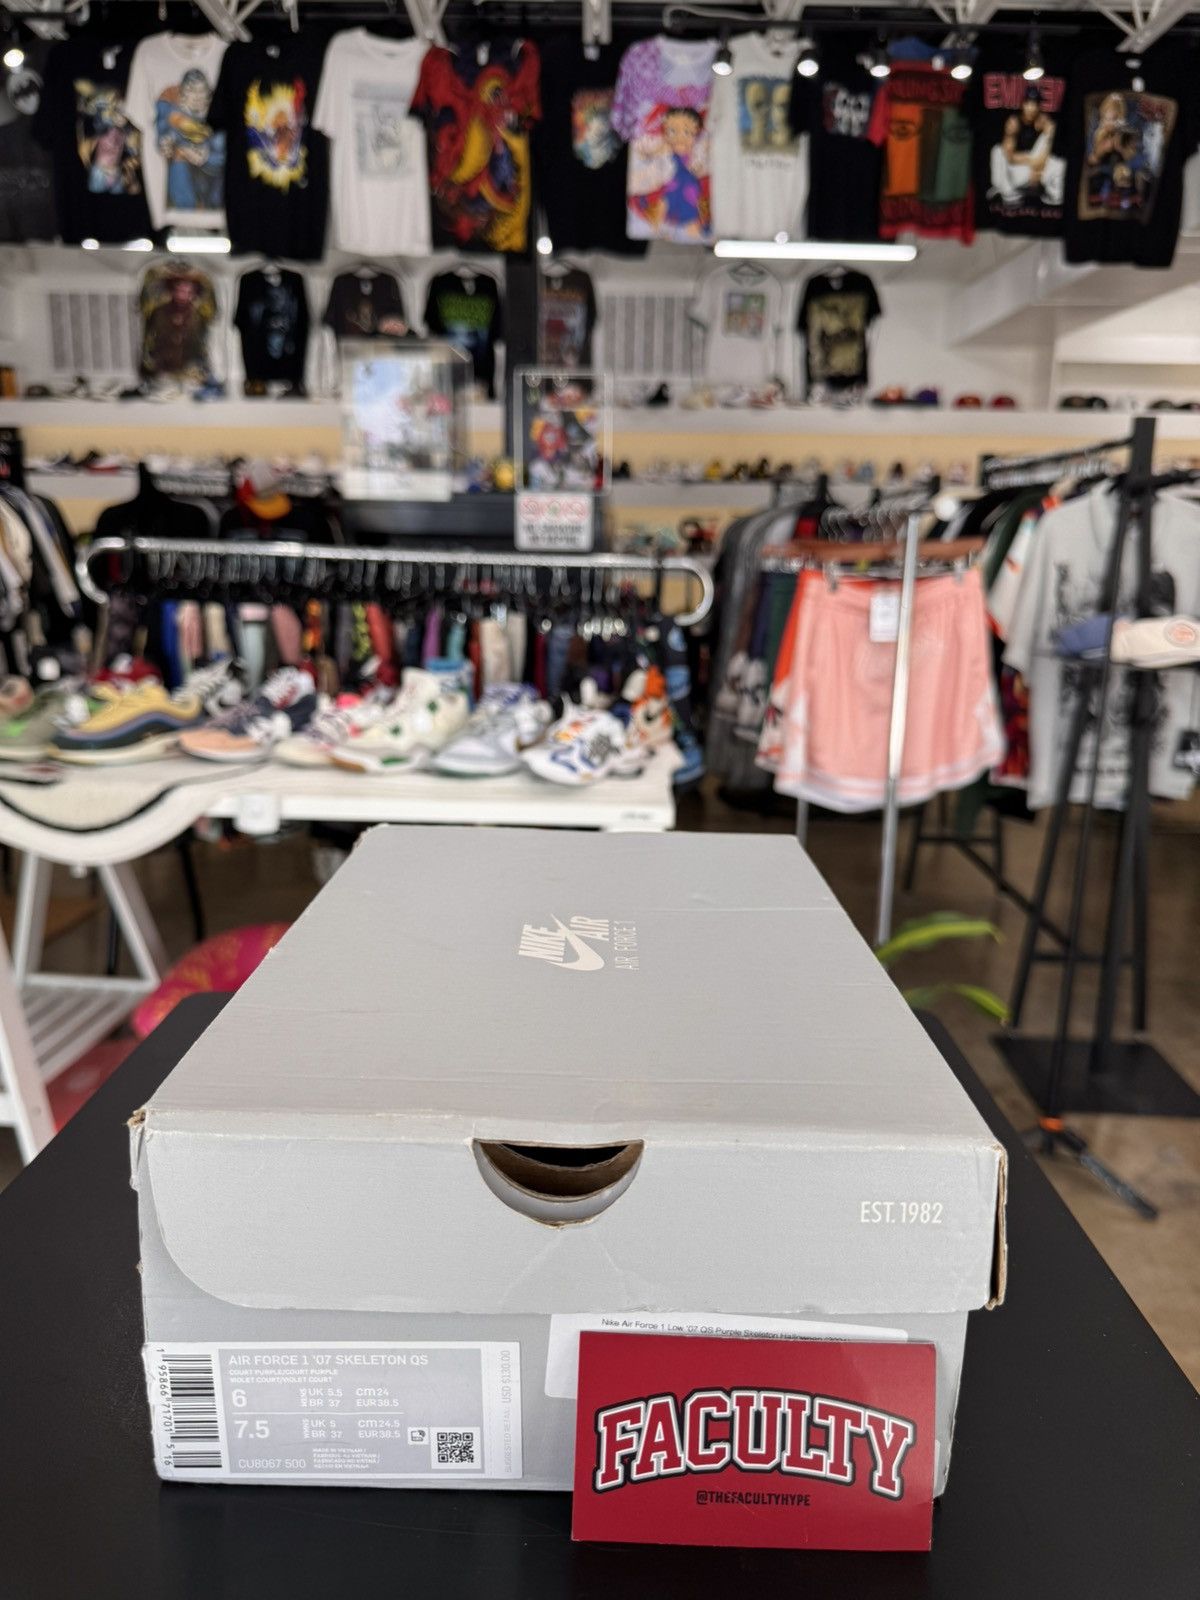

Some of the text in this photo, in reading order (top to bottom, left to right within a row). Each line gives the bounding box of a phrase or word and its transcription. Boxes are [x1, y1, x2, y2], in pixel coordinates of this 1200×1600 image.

[564, 915, 609, 941] AIR
[518, 924, 566, 962] NIKE
[613, 926, 638, 951] FORCE
[614, 956, 640, 970] AIR
[900, 1201, 943, 1224] 1982
[601, 1318, 620, 1327] Nike
[621, 1319, 633, 1328] Air
[635, 1320, 659, 1330] Force
[668, 1323, 684, 1332] Low
[700, 1325, 713, 1334] QS
[715, 1326, 741, 1337] Purple
[744, 1329, 779, 1339] Skeleton
[228, 1355, 251, 1365] AIR
[254, 1355, 298, 1365] FORCE
[303, 1355, 309, 1365] 1
[335, 1355, 407, 1365] SKELETON
[410, 1355, 429, 1366] QS
[232, 1389, 247, 1407] 6
[309, 1388, 324, 1396] UK
[328, 1388, 343, 1397] 5.5
[502, 1385, 512, 1403] USD
[309, 1399, 324, 1407] BR
[328, 1399, 340, 1407] 37
[234, 1420, 270, 1438] 7.5
[311, 1420, 326, 1428] UK
[311, 1430, 326, 1438] BR
[594, 1388, 915, 1500] FACULTY
[285, 1459, 306, 1469] 500
[696, 1490, 811, 1507] @THEFACULTYHYPE
